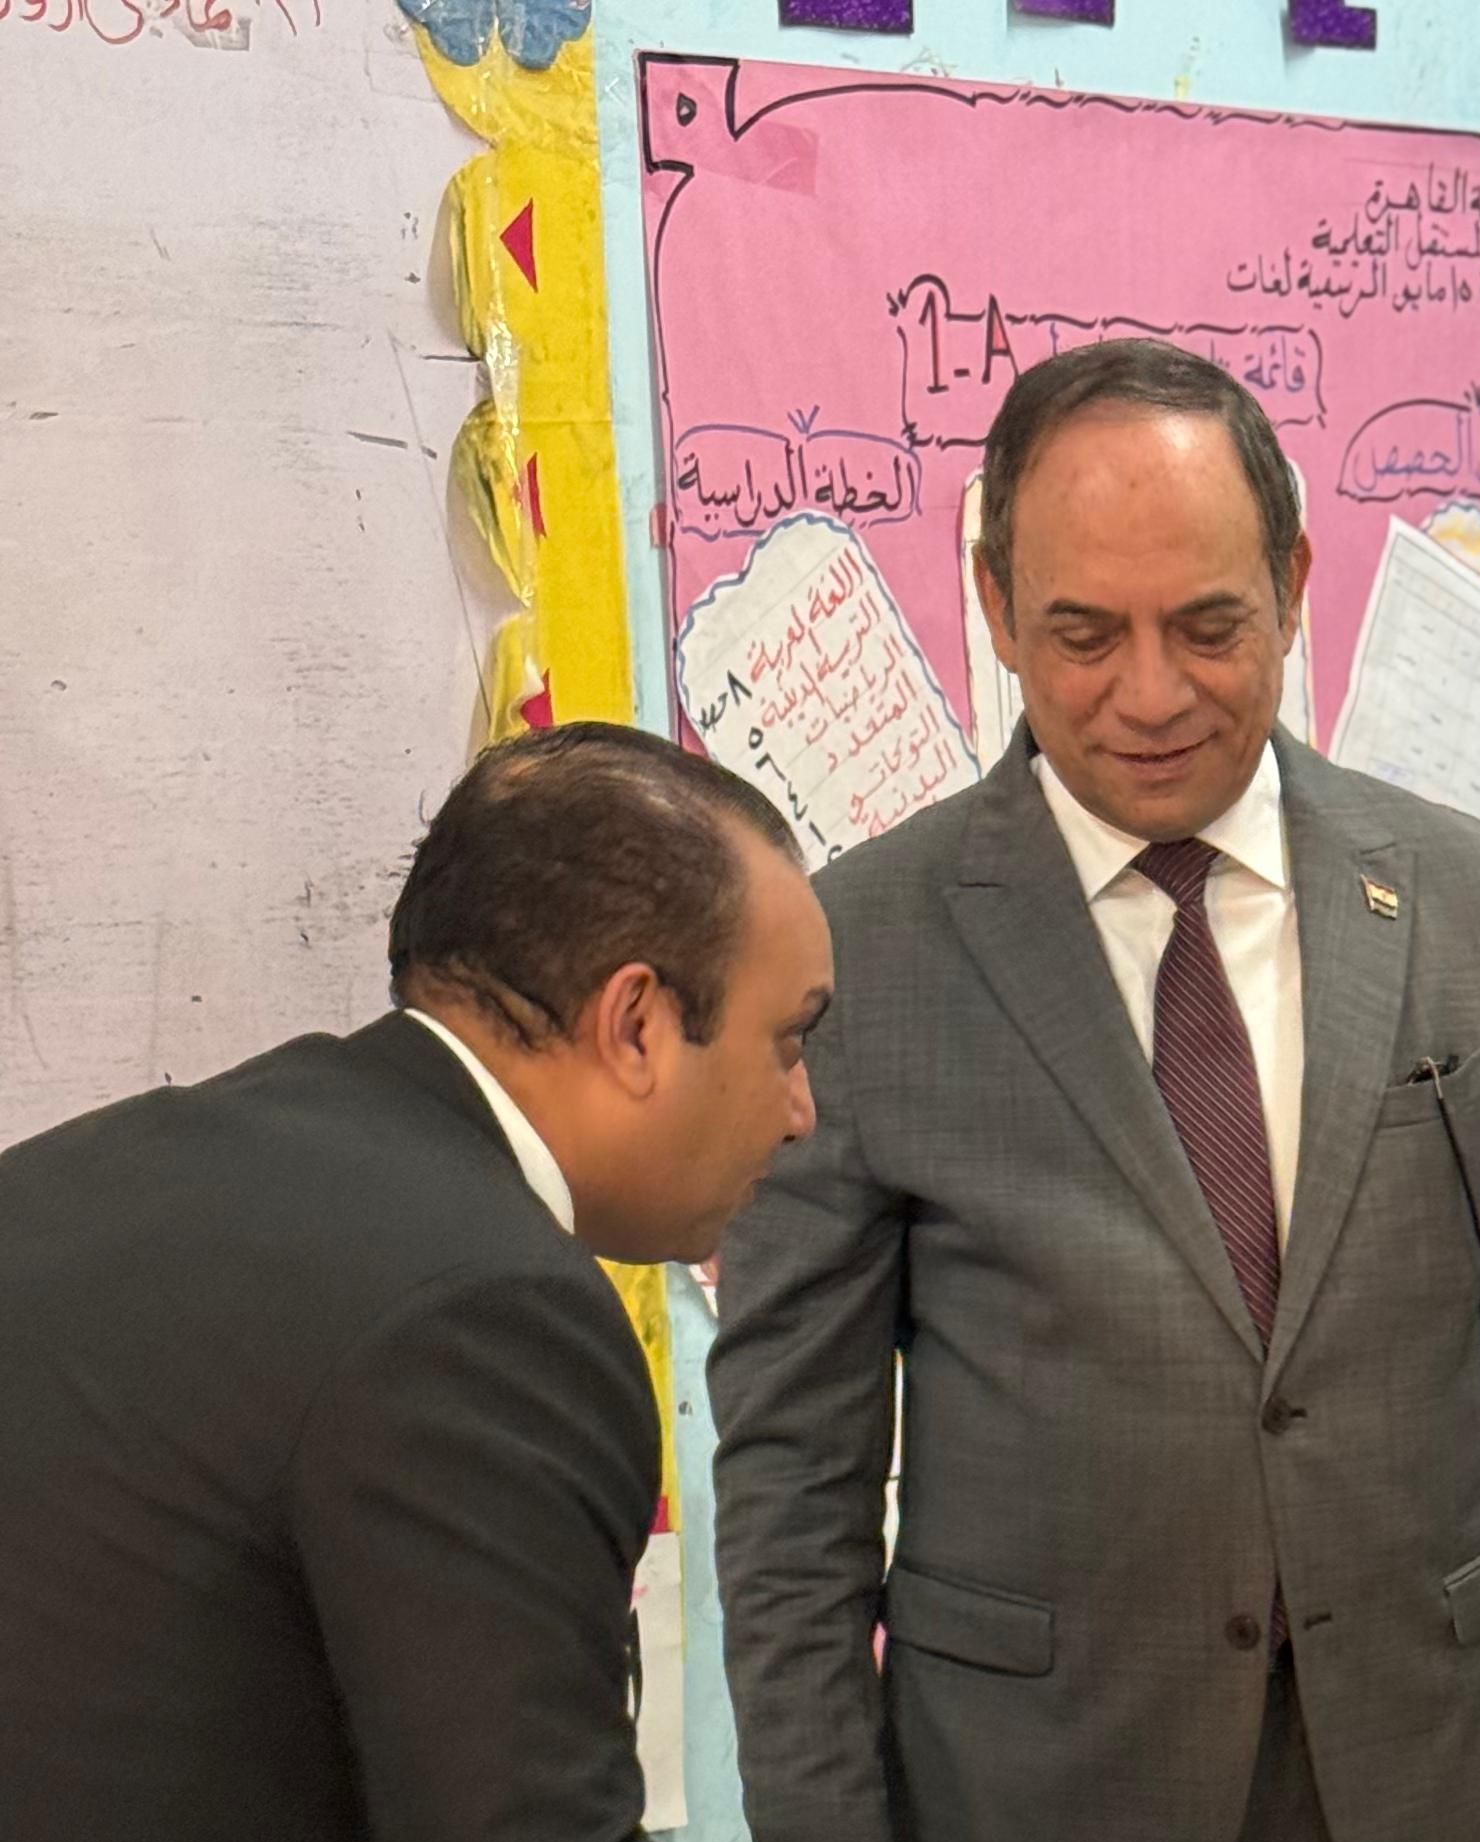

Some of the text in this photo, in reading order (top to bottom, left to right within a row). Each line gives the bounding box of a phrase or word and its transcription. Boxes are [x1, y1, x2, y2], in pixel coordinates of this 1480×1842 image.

[1365, 161, 1468, 225] القاهرة
[1226, 246, 1294, 297] لغات
[1243, 335, 1306, 393] قائمة
[677, 440, 916, 527] الخطة الدراسية
[1353, 411, 1473, 493] الحصص
[809, 547, 863, 623] اللغة
[749, 604, 822, 690] العربية
[817, 591, 881, 682] التربية
